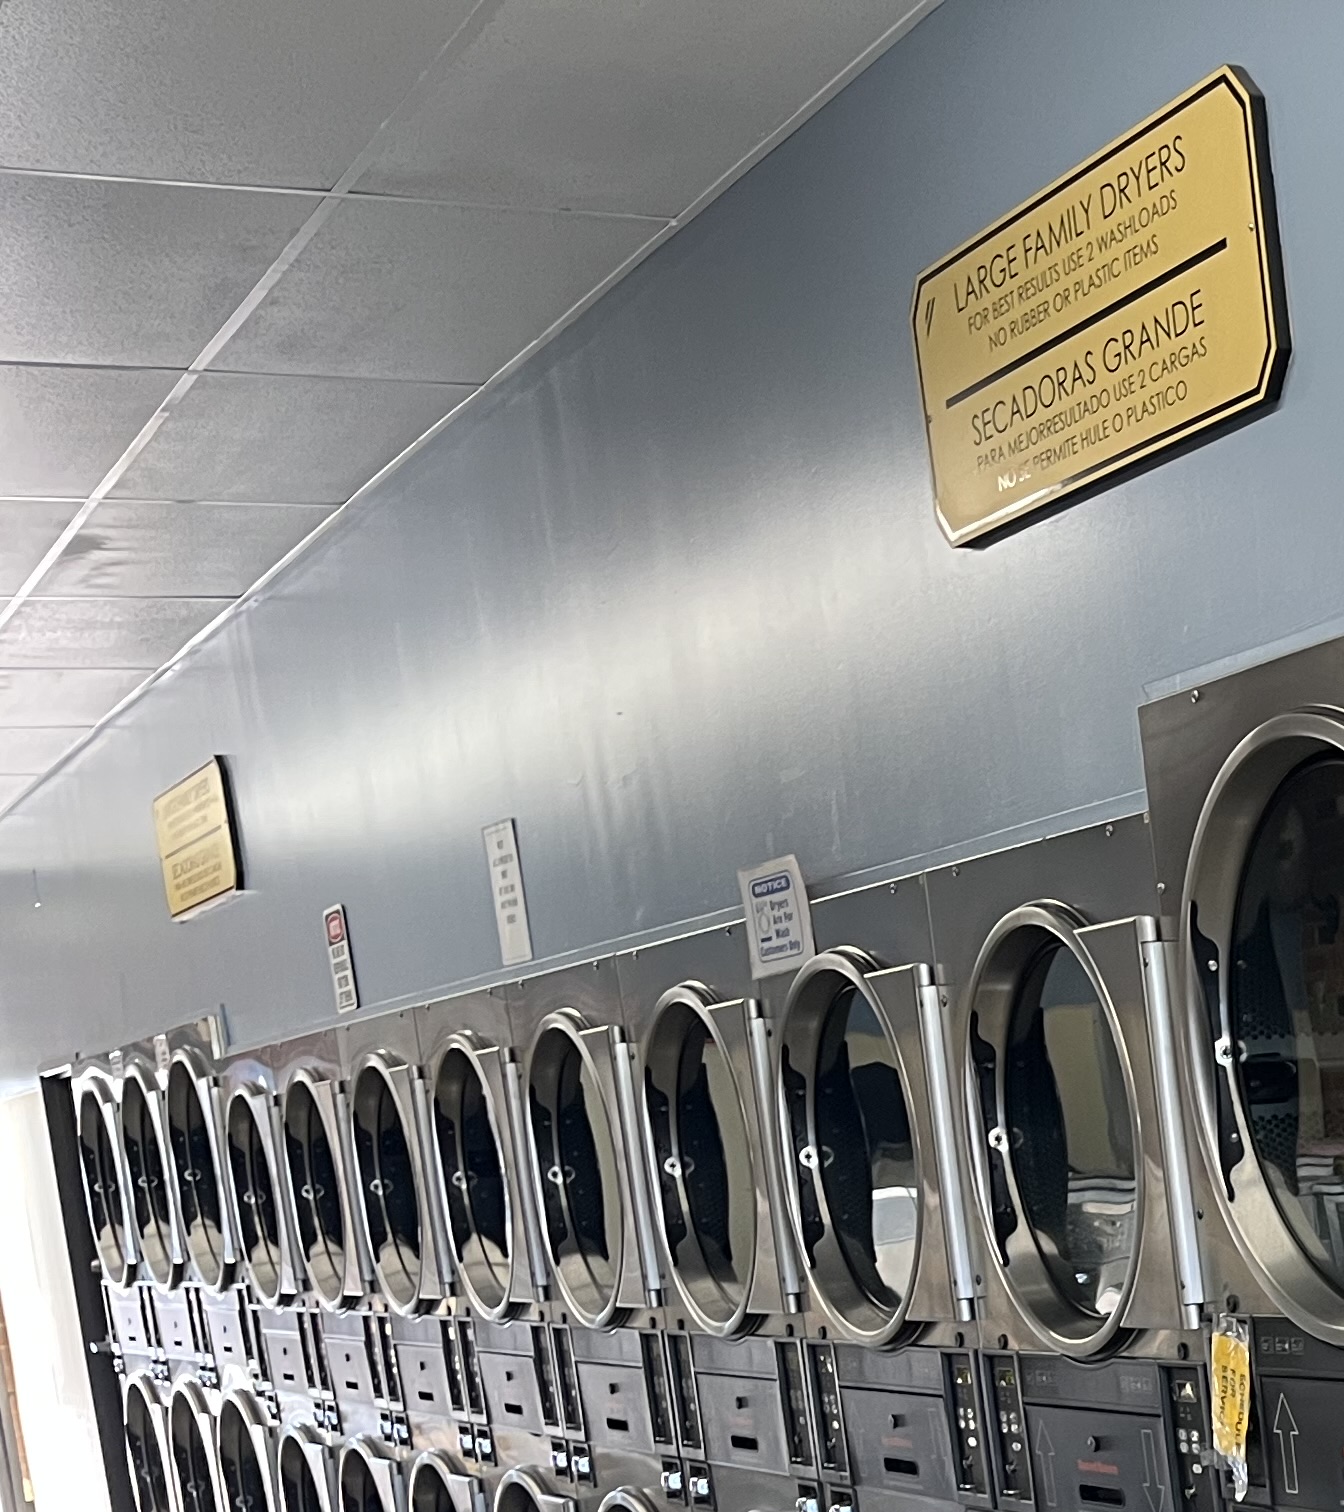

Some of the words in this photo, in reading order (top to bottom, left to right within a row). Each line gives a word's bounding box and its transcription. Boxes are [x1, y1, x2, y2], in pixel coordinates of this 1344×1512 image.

[953, 243, 1019, 313] LARGE
[1022, 193, 1092, 269] FAMILY
[1100, 135, 1186, 220] DRYERS
[967, 309, 990, 335] FOR
[992, 290, 1015, 320] BEST
[1017, 263, 1061, 302] RESULTS
[1063, 252, 1085, 276] USE
[1087, 241, 1095, 262] 2
[1095, 189, 1178, 254] WASHLOADS
[988, 327, 1007, 352] NO
[1009, 300, 1051, 339] RUBBER
[1052, 288, 1071, 313] OR
[1073, 258, 1122, 301] PLASTIC
[1124, 234, 1160, 272] ITEMS
[971, 350, 1097, 446] SECADORAS
[1102, 288, 1206, 373] GRANDE
[976, 443, 1005, 473] PARA
[1113, 374, 1136, 402] USE
[1138, 369, 1148, 389] 2
[1149, 336, 1208, 382] CARGAS
[997, 470, 1017, 492] NO
[1032, 436, 1079, 471] PERMITE
[1080, 419, 1111, 450] HULE
[1112, 413, 1124, 433] O
[1126, 380, 1188, 427] PLASTICO
[754, 877, 788, 895] NOTICE
